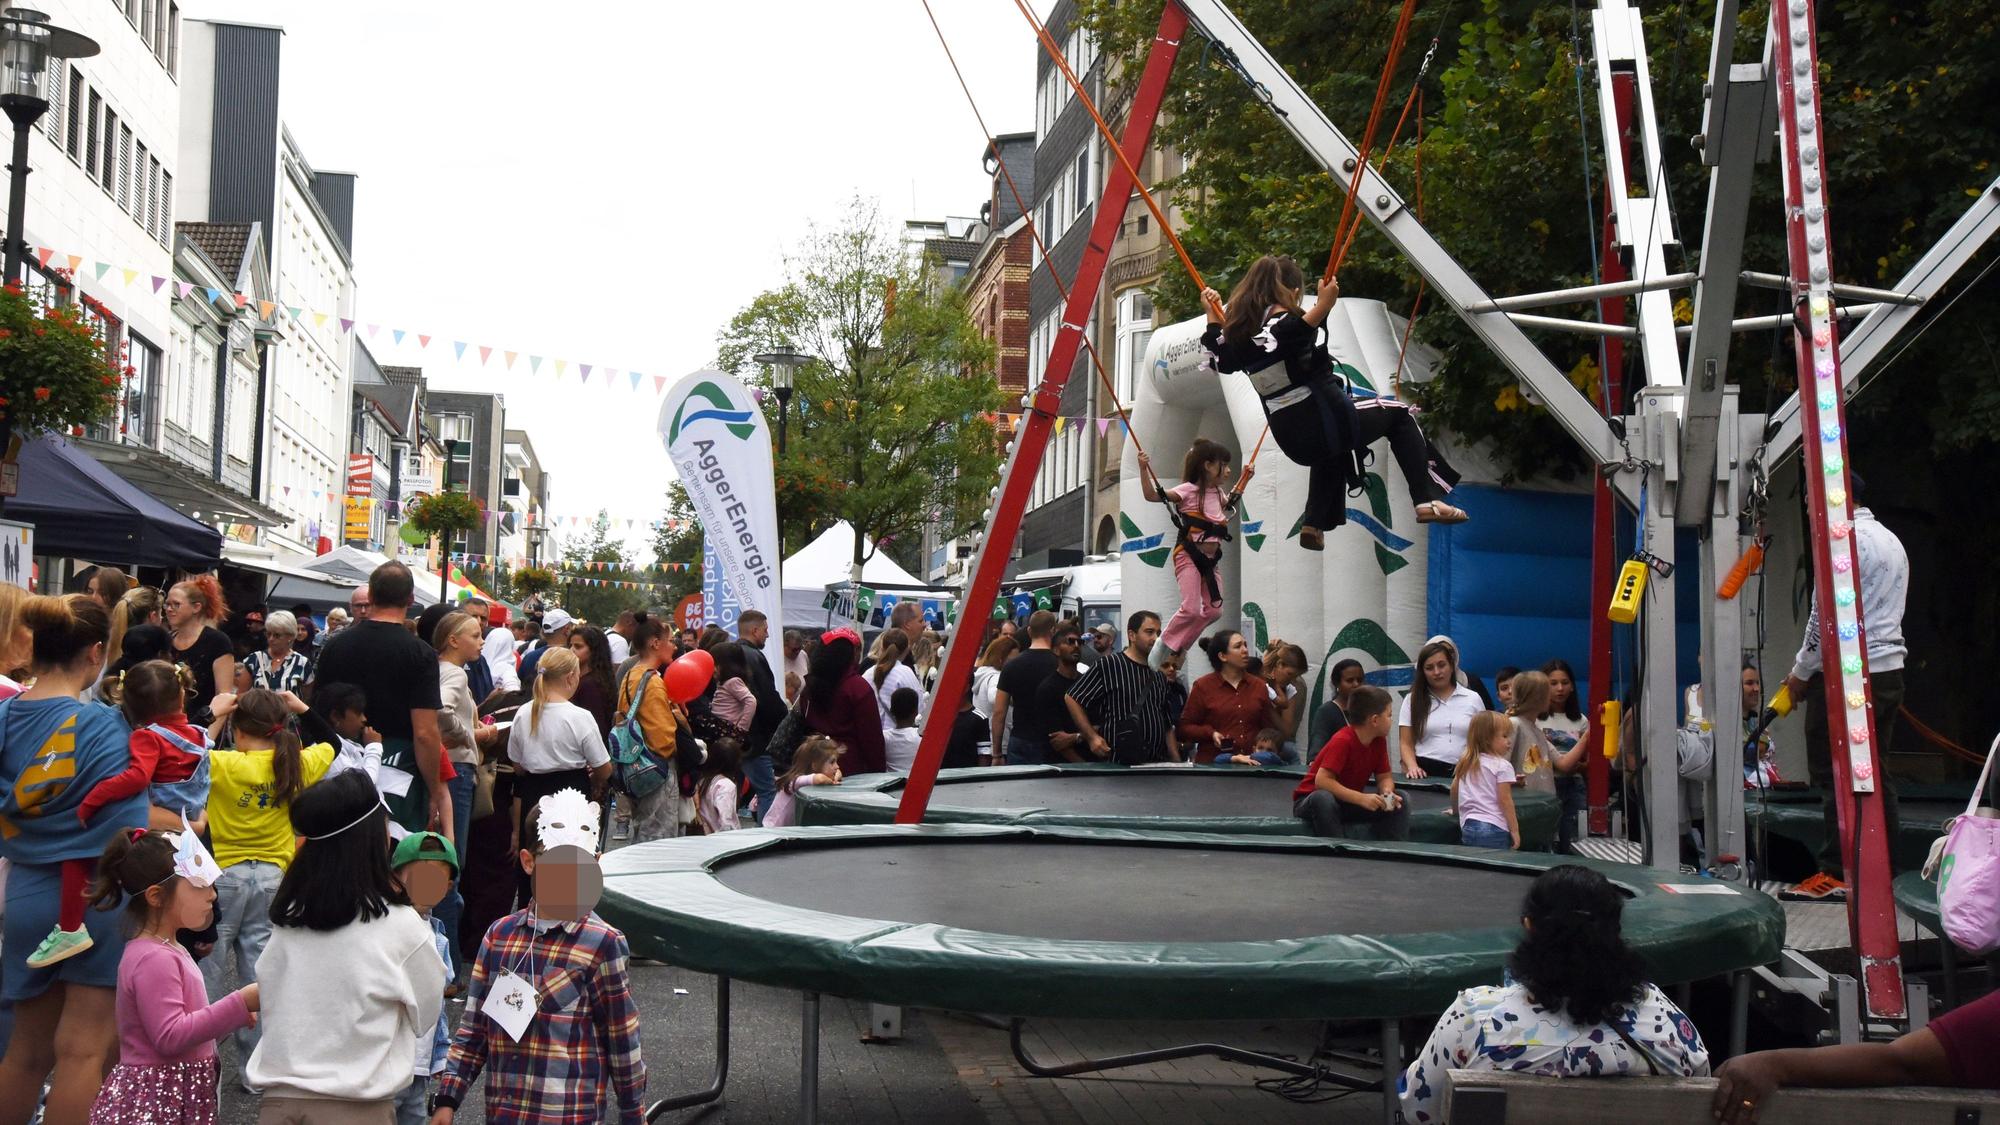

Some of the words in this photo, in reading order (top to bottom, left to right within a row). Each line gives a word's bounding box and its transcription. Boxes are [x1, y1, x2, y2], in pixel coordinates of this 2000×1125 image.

[683, 459, 715, 520] Gemeinsam
[711, 517, 723, 539] für
[719, 537, 739, 573] unsere
[735, 572, 755, 609] Region
[693, 439, 771, 590] AggerEnergie
[685, 602, 702, 617] BE
[237, 791, 253, 808] GGS
[250, 782, 278, 794] STEIN
